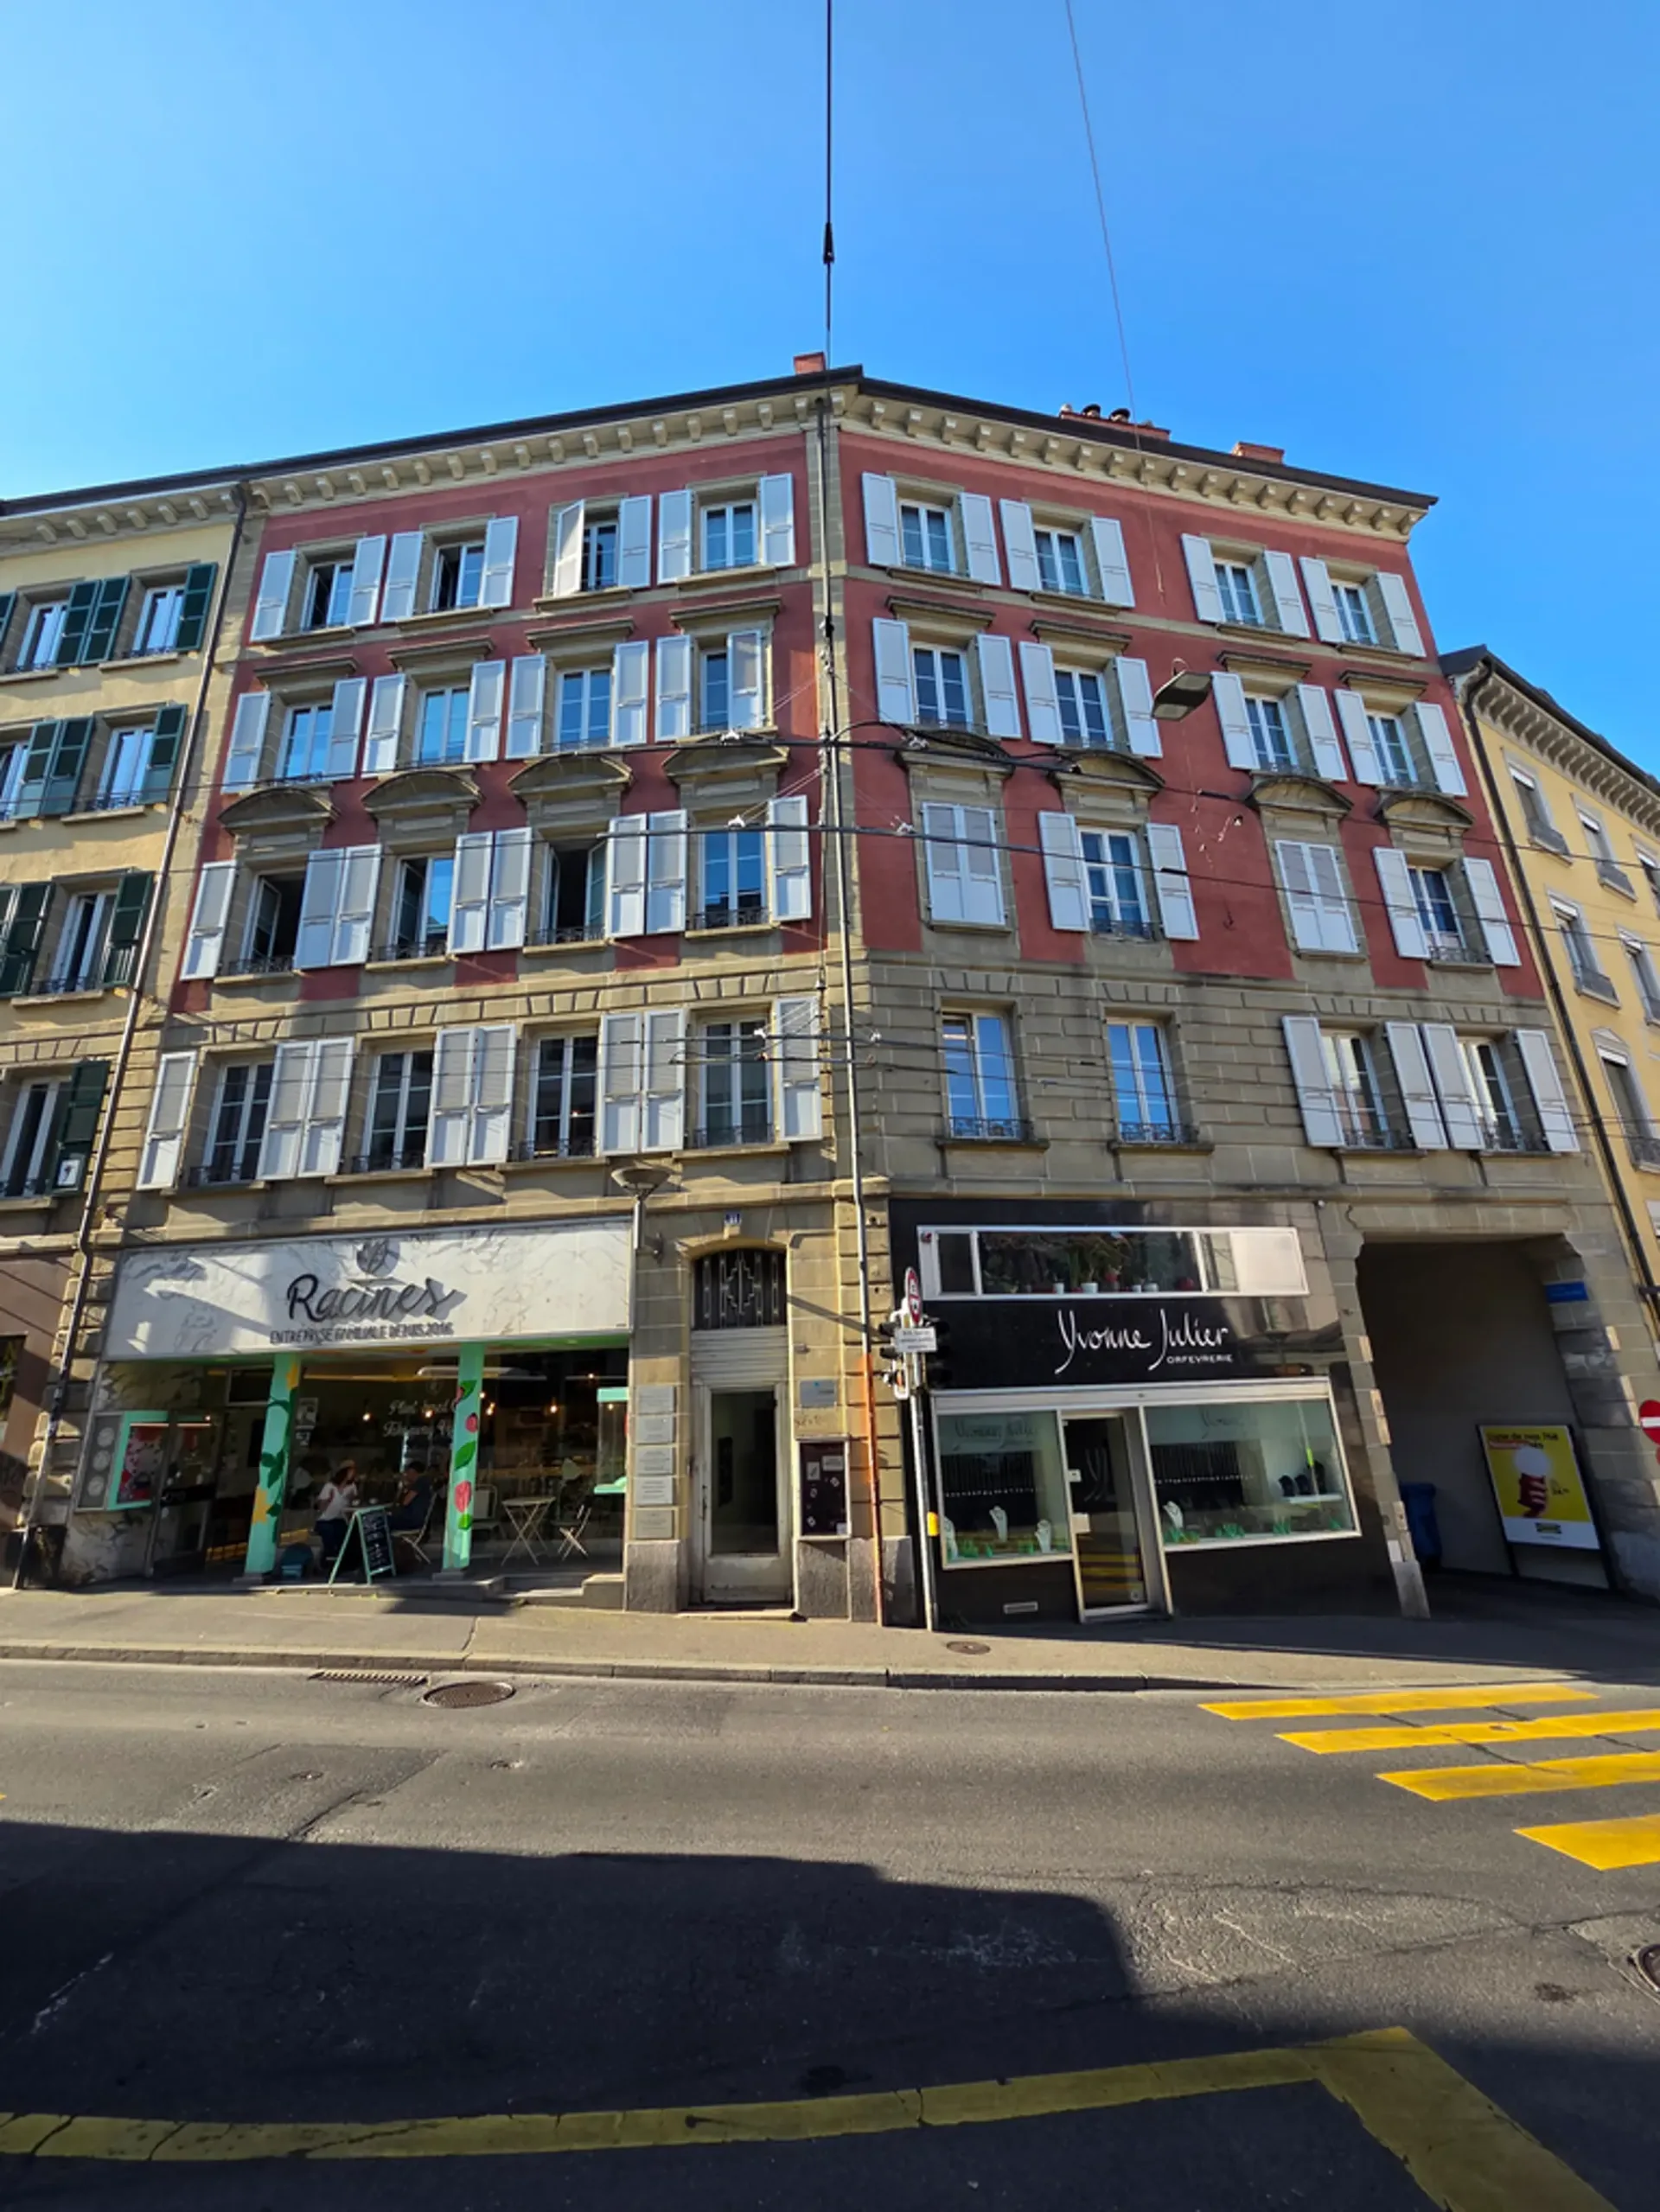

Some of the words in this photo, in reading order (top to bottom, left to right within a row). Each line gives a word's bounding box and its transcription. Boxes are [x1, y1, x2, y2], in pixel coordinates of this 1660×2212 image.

[287, 1273, 456, 1323] Racines
[1055, 1310, 1152, 1375] Yvonne
[1148, 1308, 1229, 1371] Julier
